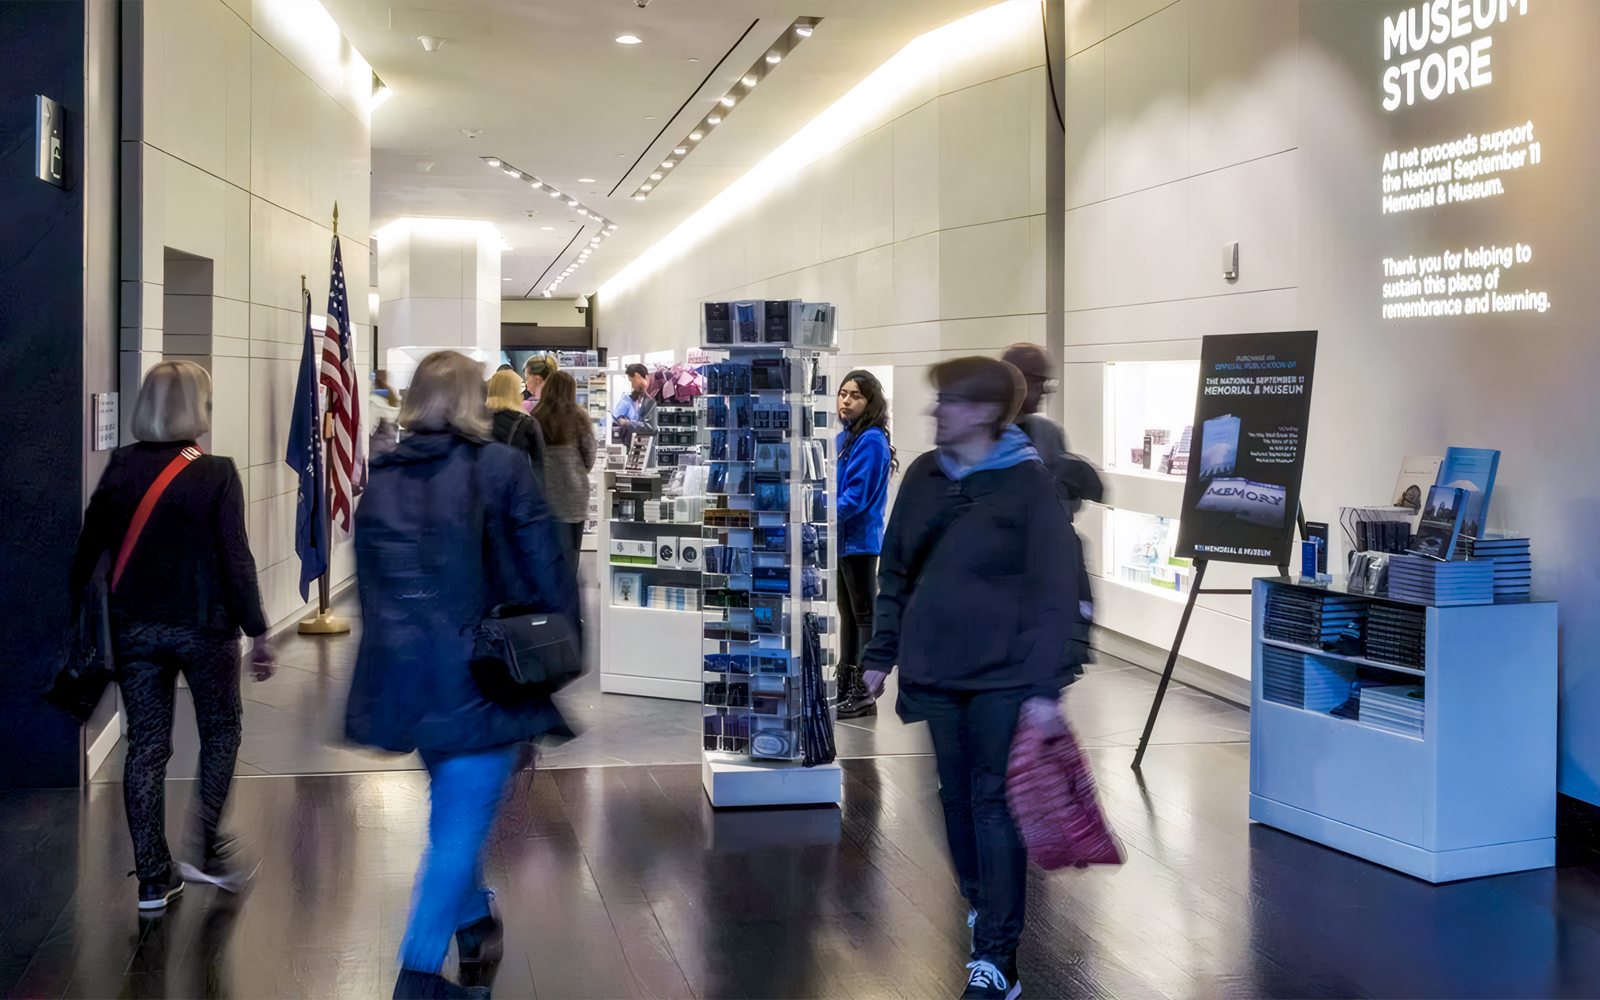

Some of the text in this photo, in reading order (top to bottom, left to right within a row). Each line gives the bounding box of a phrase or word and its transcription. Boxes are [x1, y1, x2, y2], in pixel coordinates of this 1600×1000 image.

[1382, 36, 1492, 111] STORE
[1382, 120, 1534, 172] All net proceeds support
[1382, 142, 1541, 193] the National September 11
[1382, 178, 1504, 214] Memorial & Museum.
[1383, 242, 1532, 277] Thank you for helping to
[1383, 267, 1500, 298] sustain this place of
[1383, 289, 1551, 319] remembrance and learning.
[1204, 386, 1252, 395] MEMORIAL
[1262, 385, 1303, 395] MUSEUM
[1206, 377, 1218, 385] THE
[1220, 377, 1255, 385] NATIONAL
